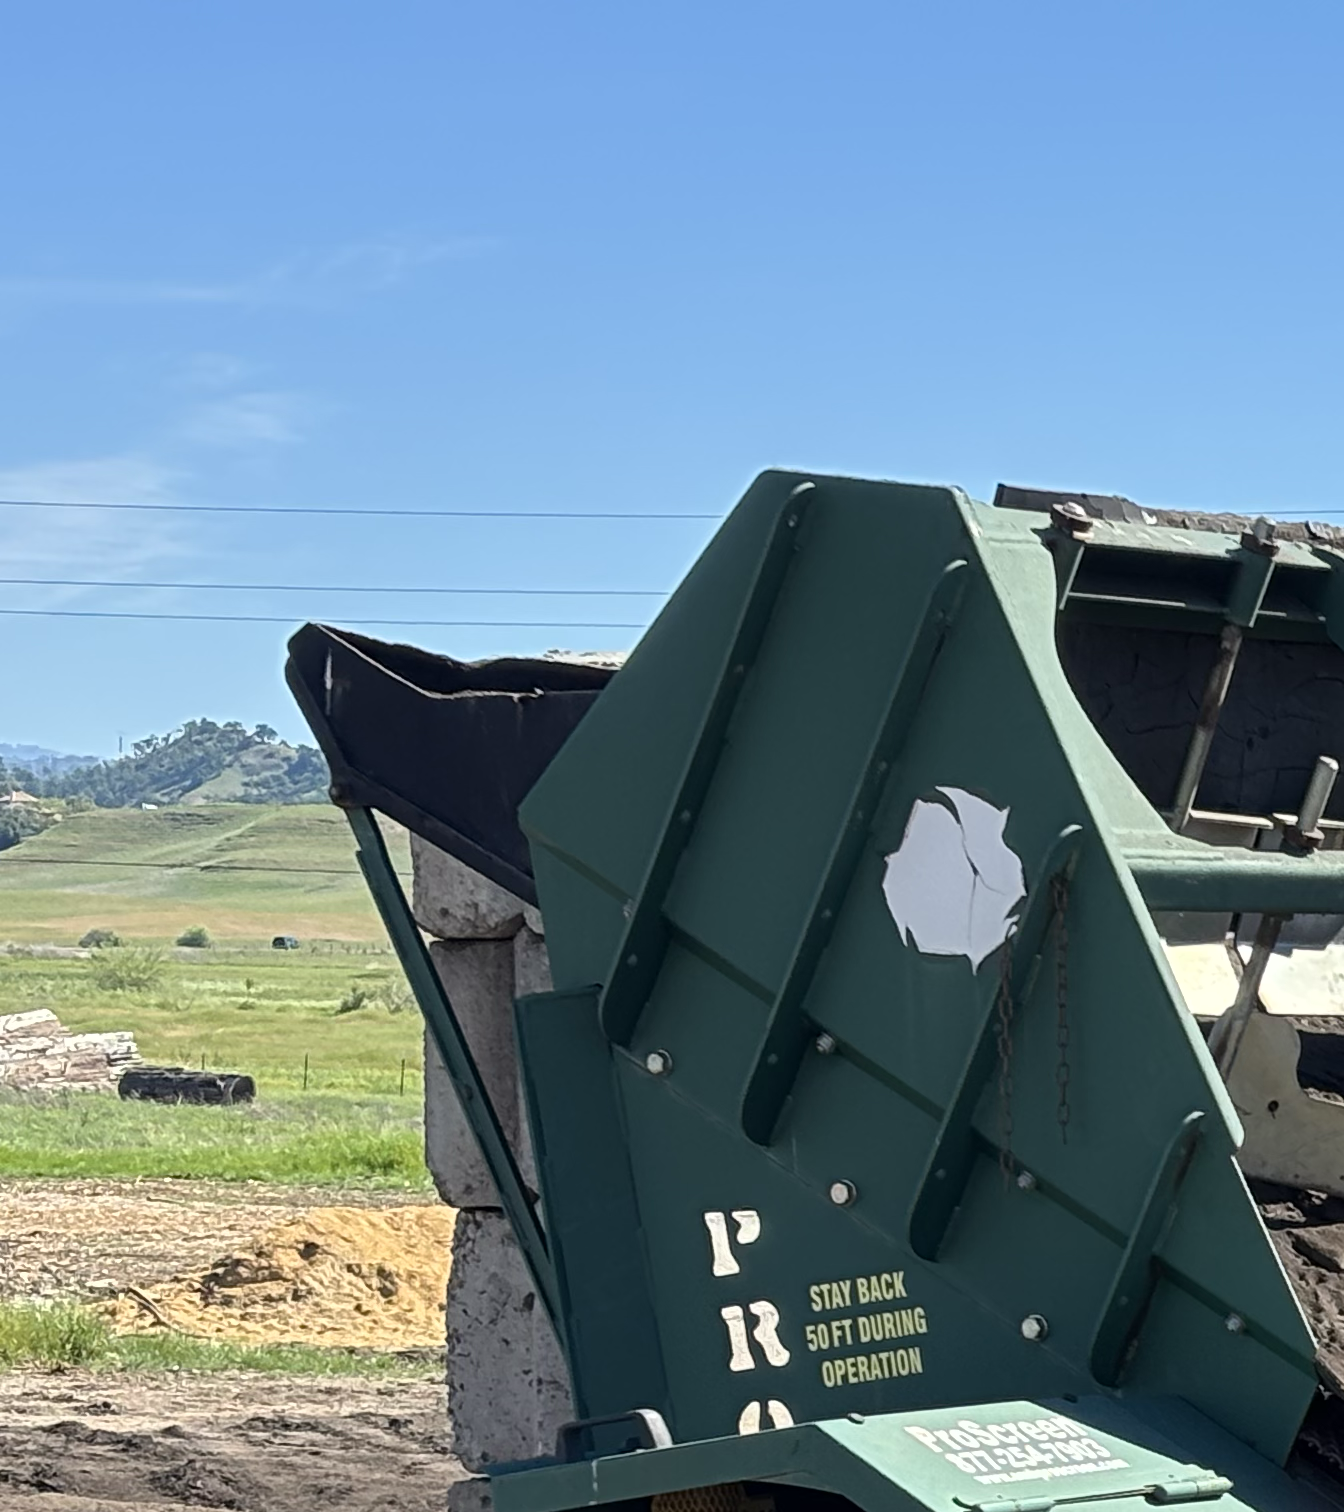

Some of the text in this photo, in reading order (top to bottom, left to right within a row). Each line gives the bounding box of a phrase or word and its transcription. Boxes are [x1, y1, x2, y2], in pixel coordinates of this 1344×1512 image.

[809, 1271, 908, 1312] STAY BACK
[857, 1306, 928, 1343] DURING
[821, 1346, 923, 1388] OPERATION
[904, 1415, 1088, 1453] ProScreen
